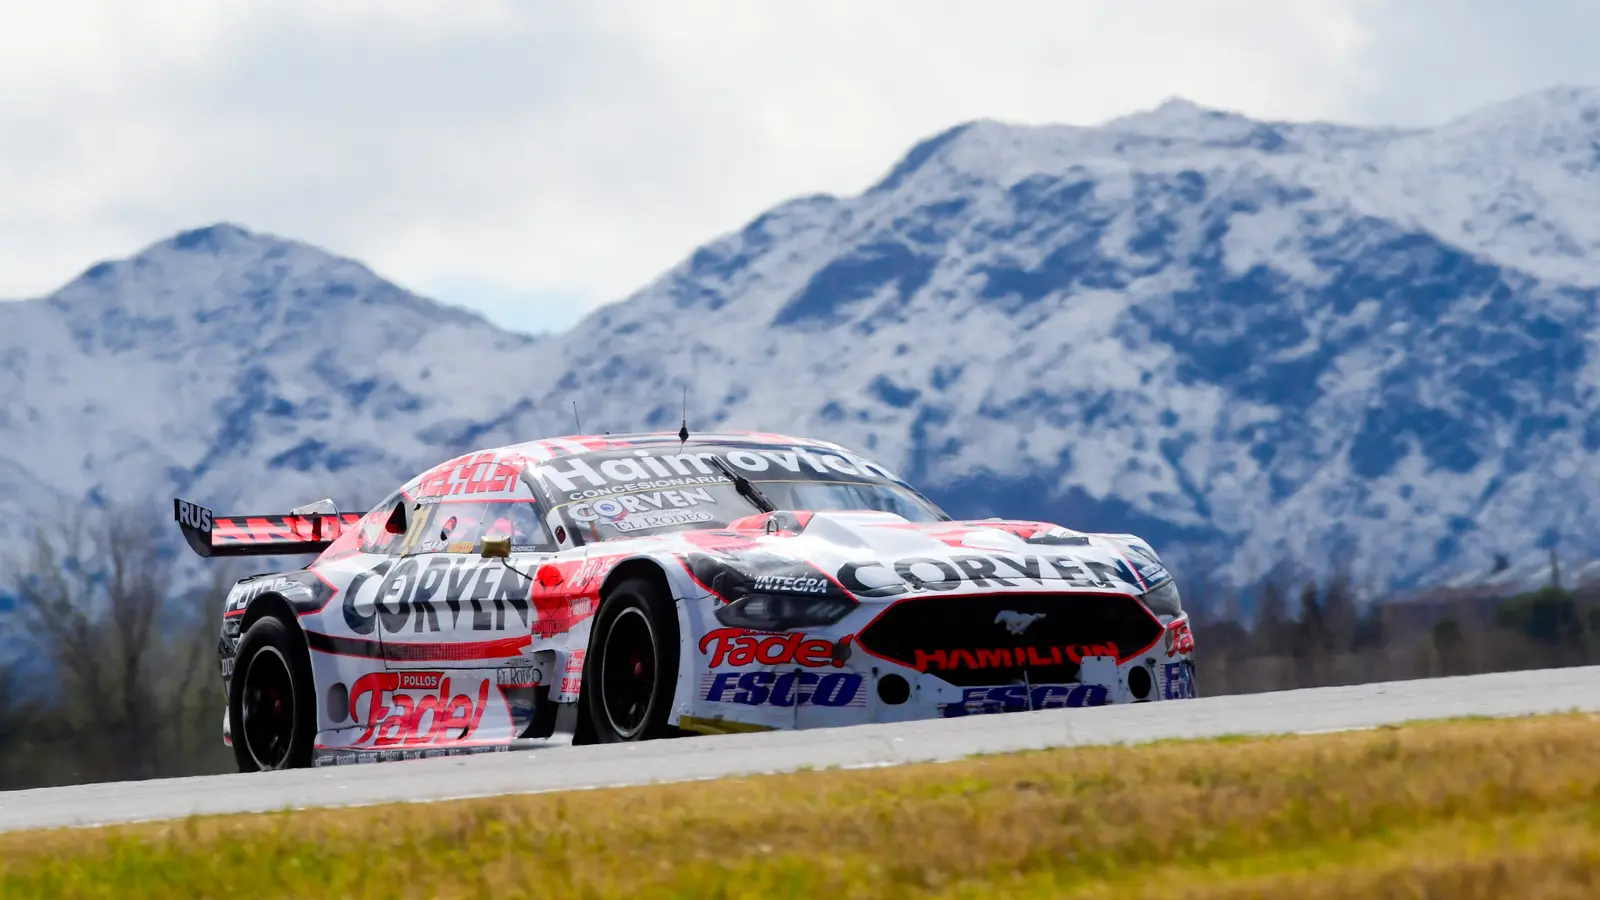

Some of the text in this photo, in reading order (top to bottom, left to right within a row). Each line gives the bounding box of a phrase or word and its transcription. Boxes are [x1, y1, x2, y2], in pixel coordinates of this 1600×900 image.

[540, 447, 892, 492] Haimovich
[179, 501, 212, 533] RUS
[568, 487, 717, 522] CORVEN
[644, 510, 714, 529] RODEO
[752, 574, 828, 593] INTEGRA
[837, 554, 1138, 597] CORVEN
[342, 556, 537, 635] CORVEN
[914, 641, 1121, 672] HAMILTON
[403, 675, 437, 687] POLLOS
[706, 671, 863, 706] ESCO
[350, 672, 490, 745] Fadel
